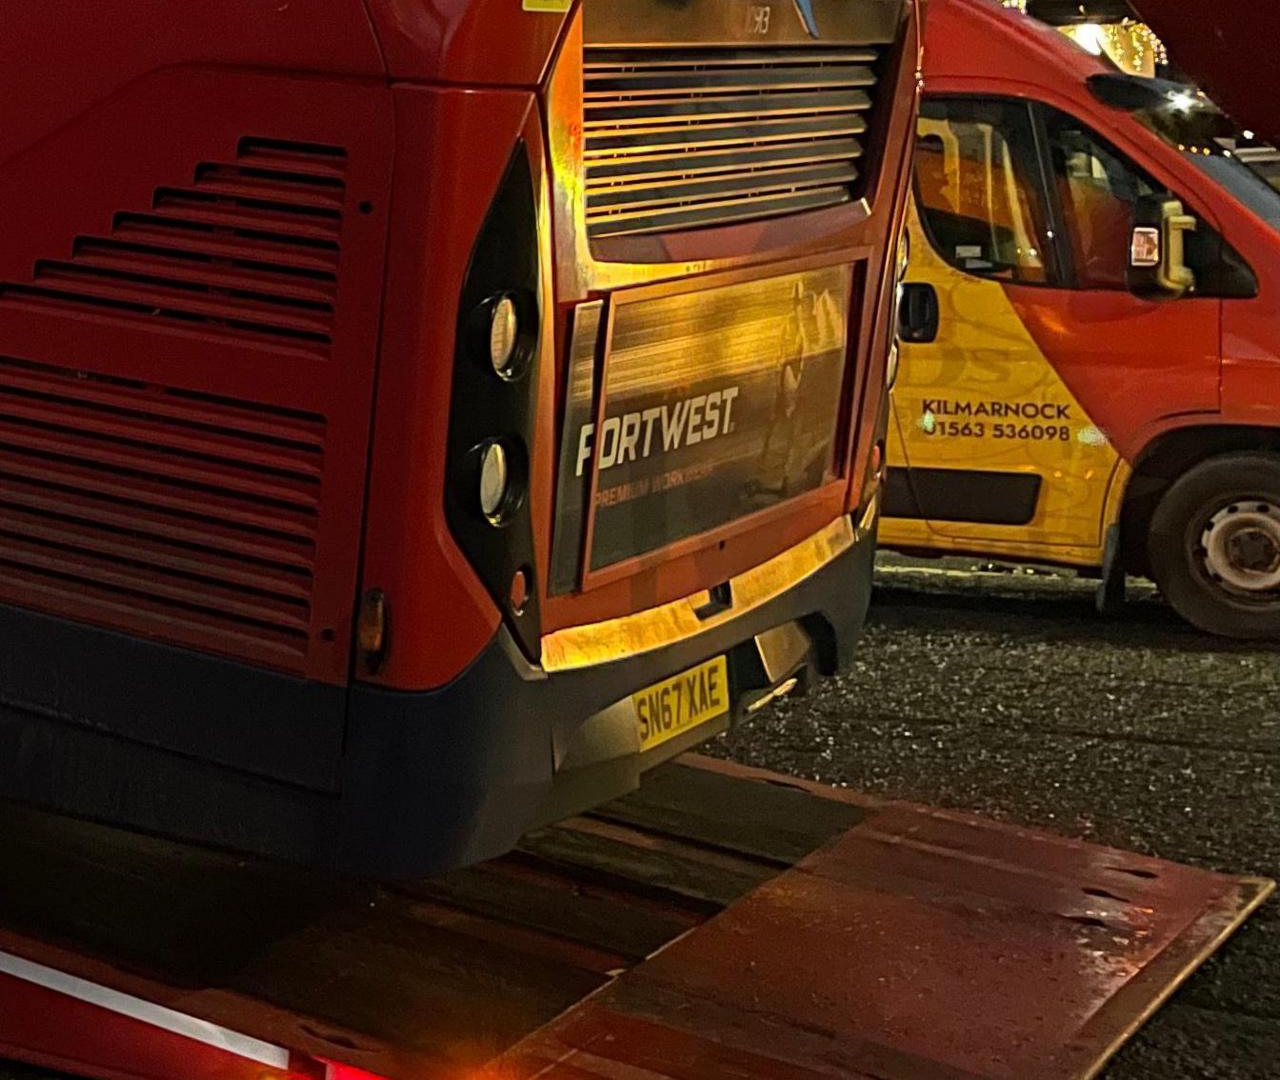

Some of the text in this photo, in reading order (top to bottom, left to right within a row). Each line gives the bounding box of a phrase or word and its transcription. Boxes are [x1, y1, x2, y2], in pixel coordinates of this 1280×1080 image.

[922, 399, 1071, 420] KILMARNOCK
[992, 424, 1070, 442] 536098
[637, 665, 721, 743] SN67 XAE
